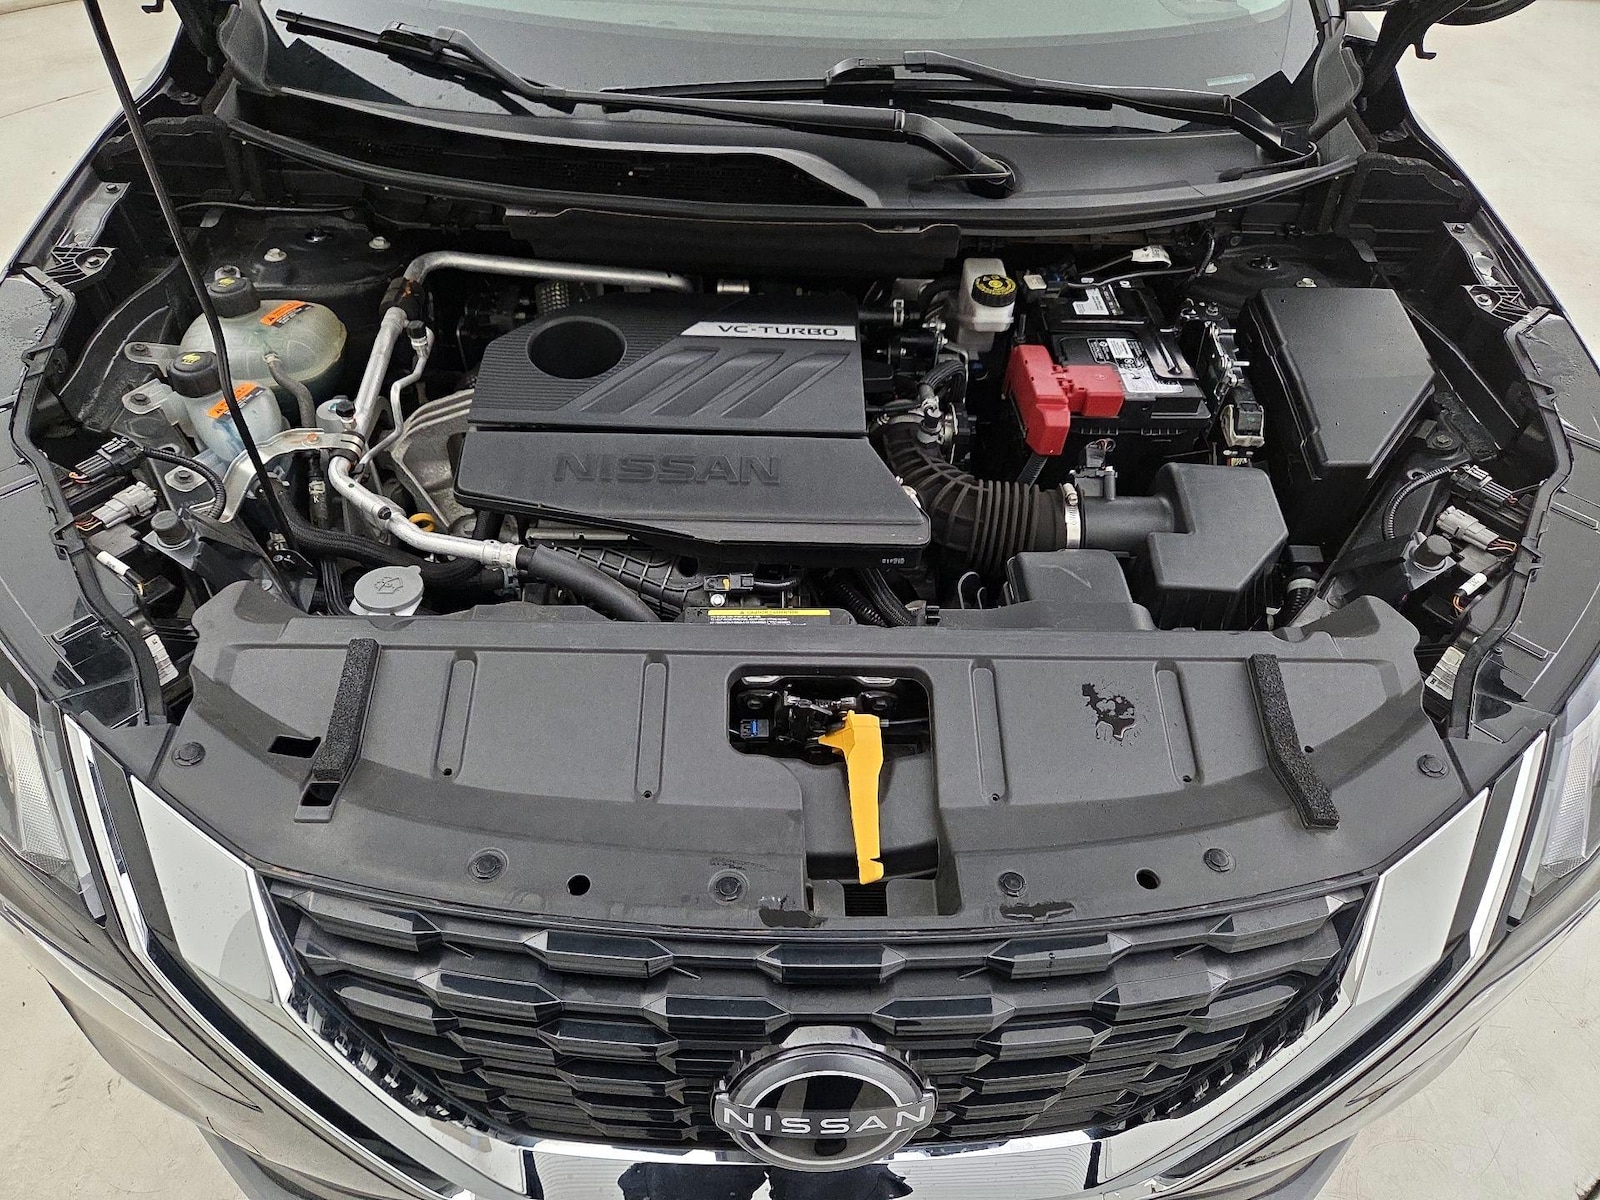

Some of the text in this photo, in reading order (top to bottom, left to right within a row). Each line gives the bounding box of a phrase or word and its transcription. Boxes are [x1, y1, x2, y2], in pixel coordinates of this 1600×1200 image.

[717, 325, 839, 337] VC-TURBO
[553, 453, 780, 486] NISSAN
[723, 1106, 926, 1134] NISSAN
